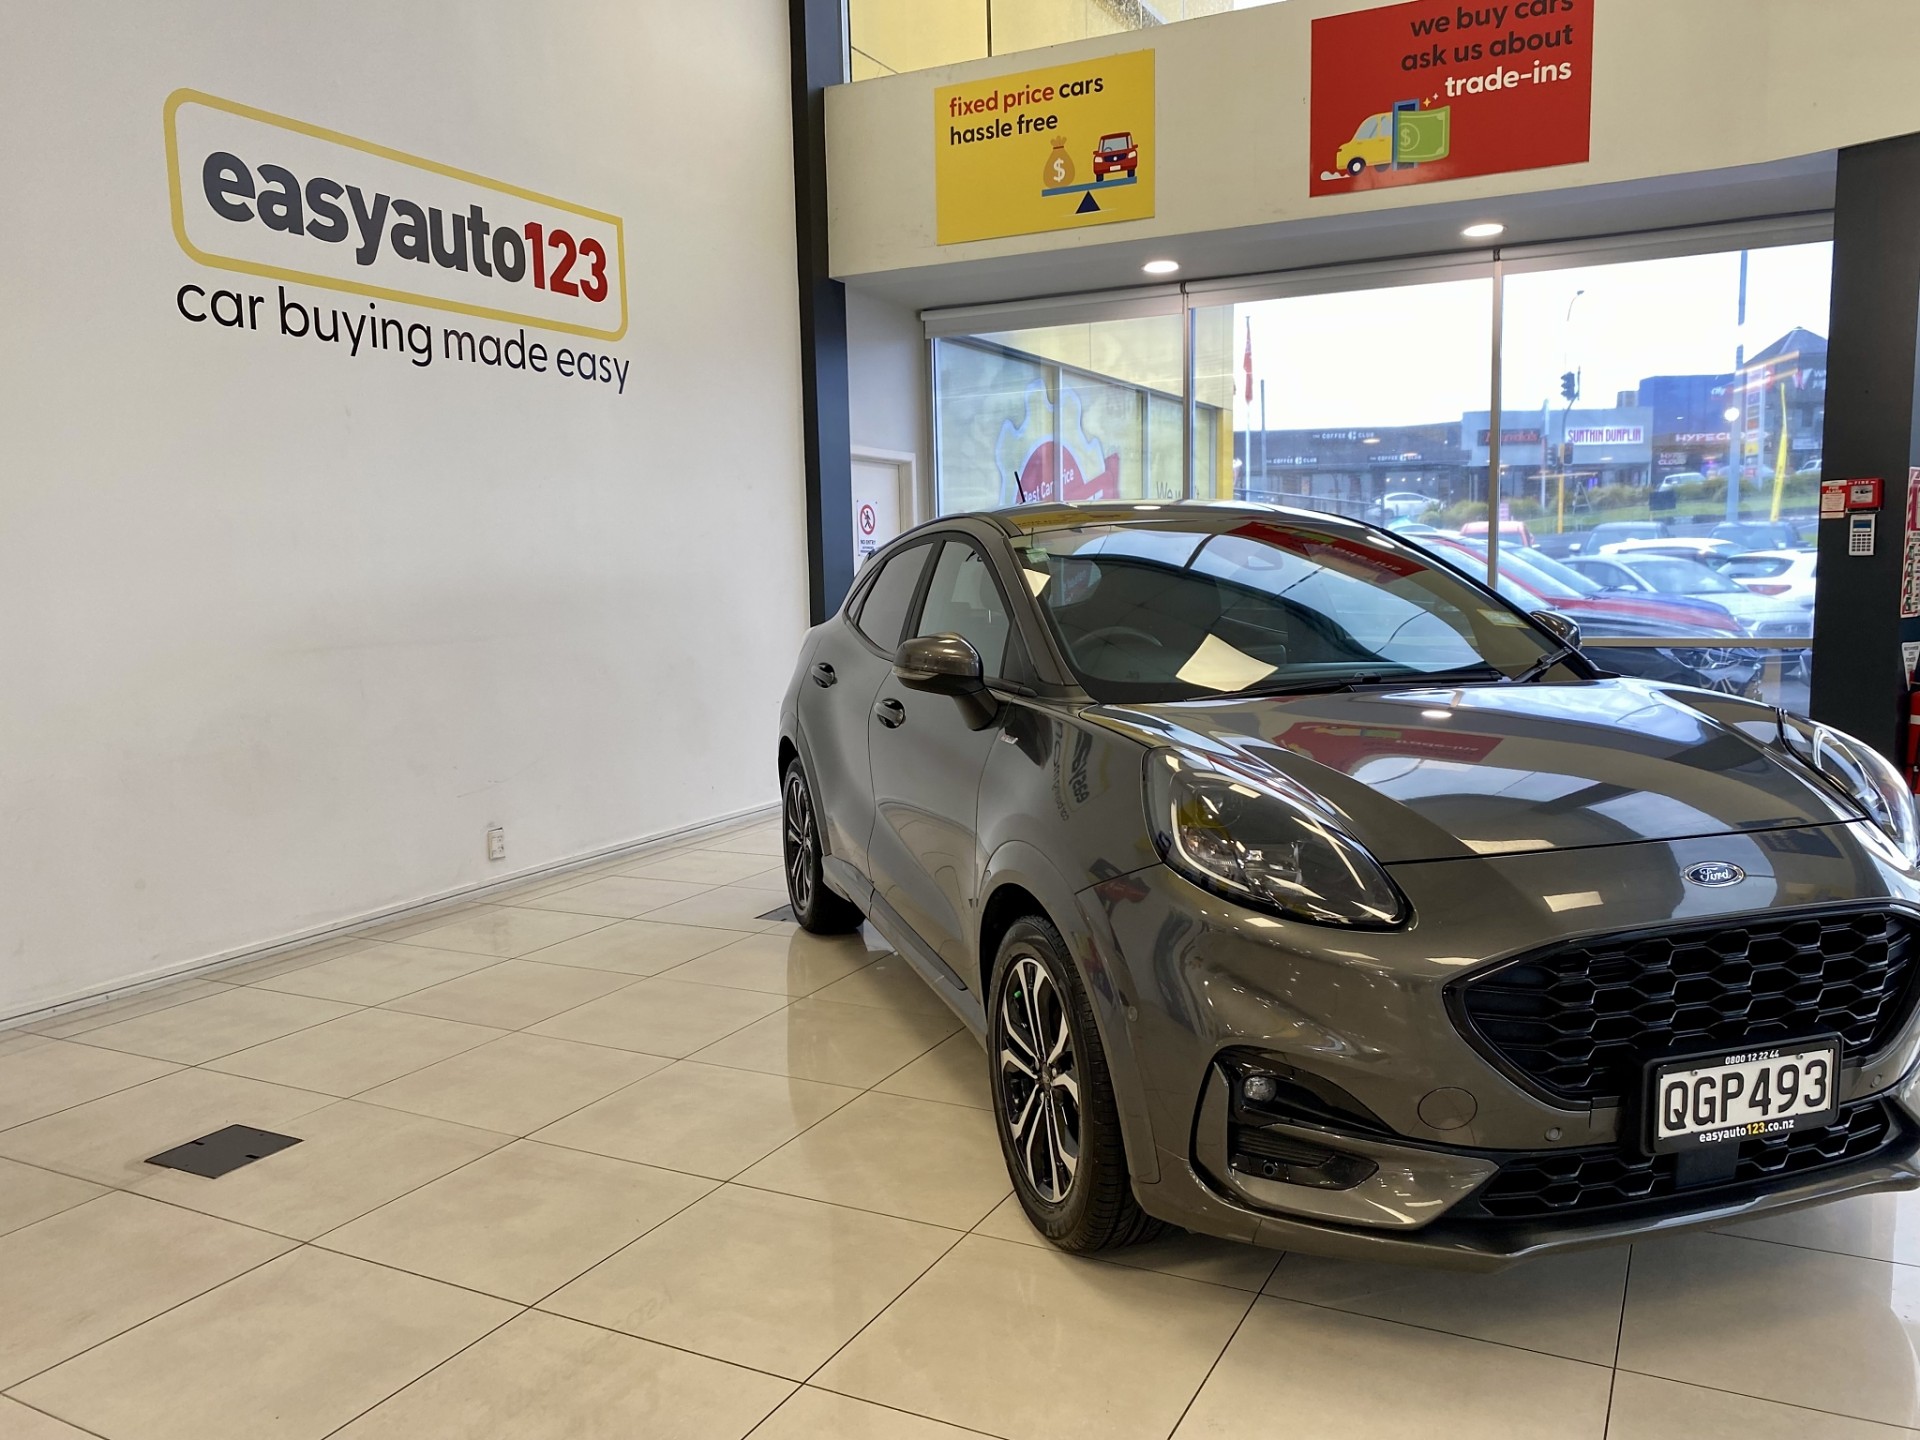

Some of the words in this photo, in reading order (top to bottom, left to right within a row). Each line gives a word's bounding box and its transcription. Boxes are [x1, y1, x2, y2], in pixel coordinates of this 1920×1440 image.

[1410, 15, 1450, 37] we
[1456, 6, 1508, 29] buy
[1514, 0, 1574, 19] cars
[1401, 44, 1447, 71] ask
[1454, 42, 1483, 63] us
[1489, 24, 1574, 57] about
[949, 90, 998, 117] fixed
[1003, 84, 1055, 113] price
[1058, 77, 1104, 98] cars
[1445, 59, 1572, 98] trade-ins
[950, 118, 1013, 146] hassle
[1017, 114, 1058, 135] free
[202, 151, 609, 303] easyauto123
[176, 283, 265, 330] car
[278, 286, 433, 367] buying
[443, 328, 548, 373] made
[556, 346, 631, 395] easy
[1321, 432, 1346, 440] COFFEE
[1357, 431, 1375, 439] CLUB
[1302, 456, 1318, 464] CLUB
[1699, 867, 1732, 882] Ford
[1724, 1055, 1746, 1066] 0800
[1746, 1053, 1758, 1063] 12
[1757, 1051, 1769, 1061] 22
[1769, 1049, 1780, 1060] 44
[1663, 1058, 1828, 1132] QGP493
[1699, 1118, 1795, 1143] easyauto123.co.nz
